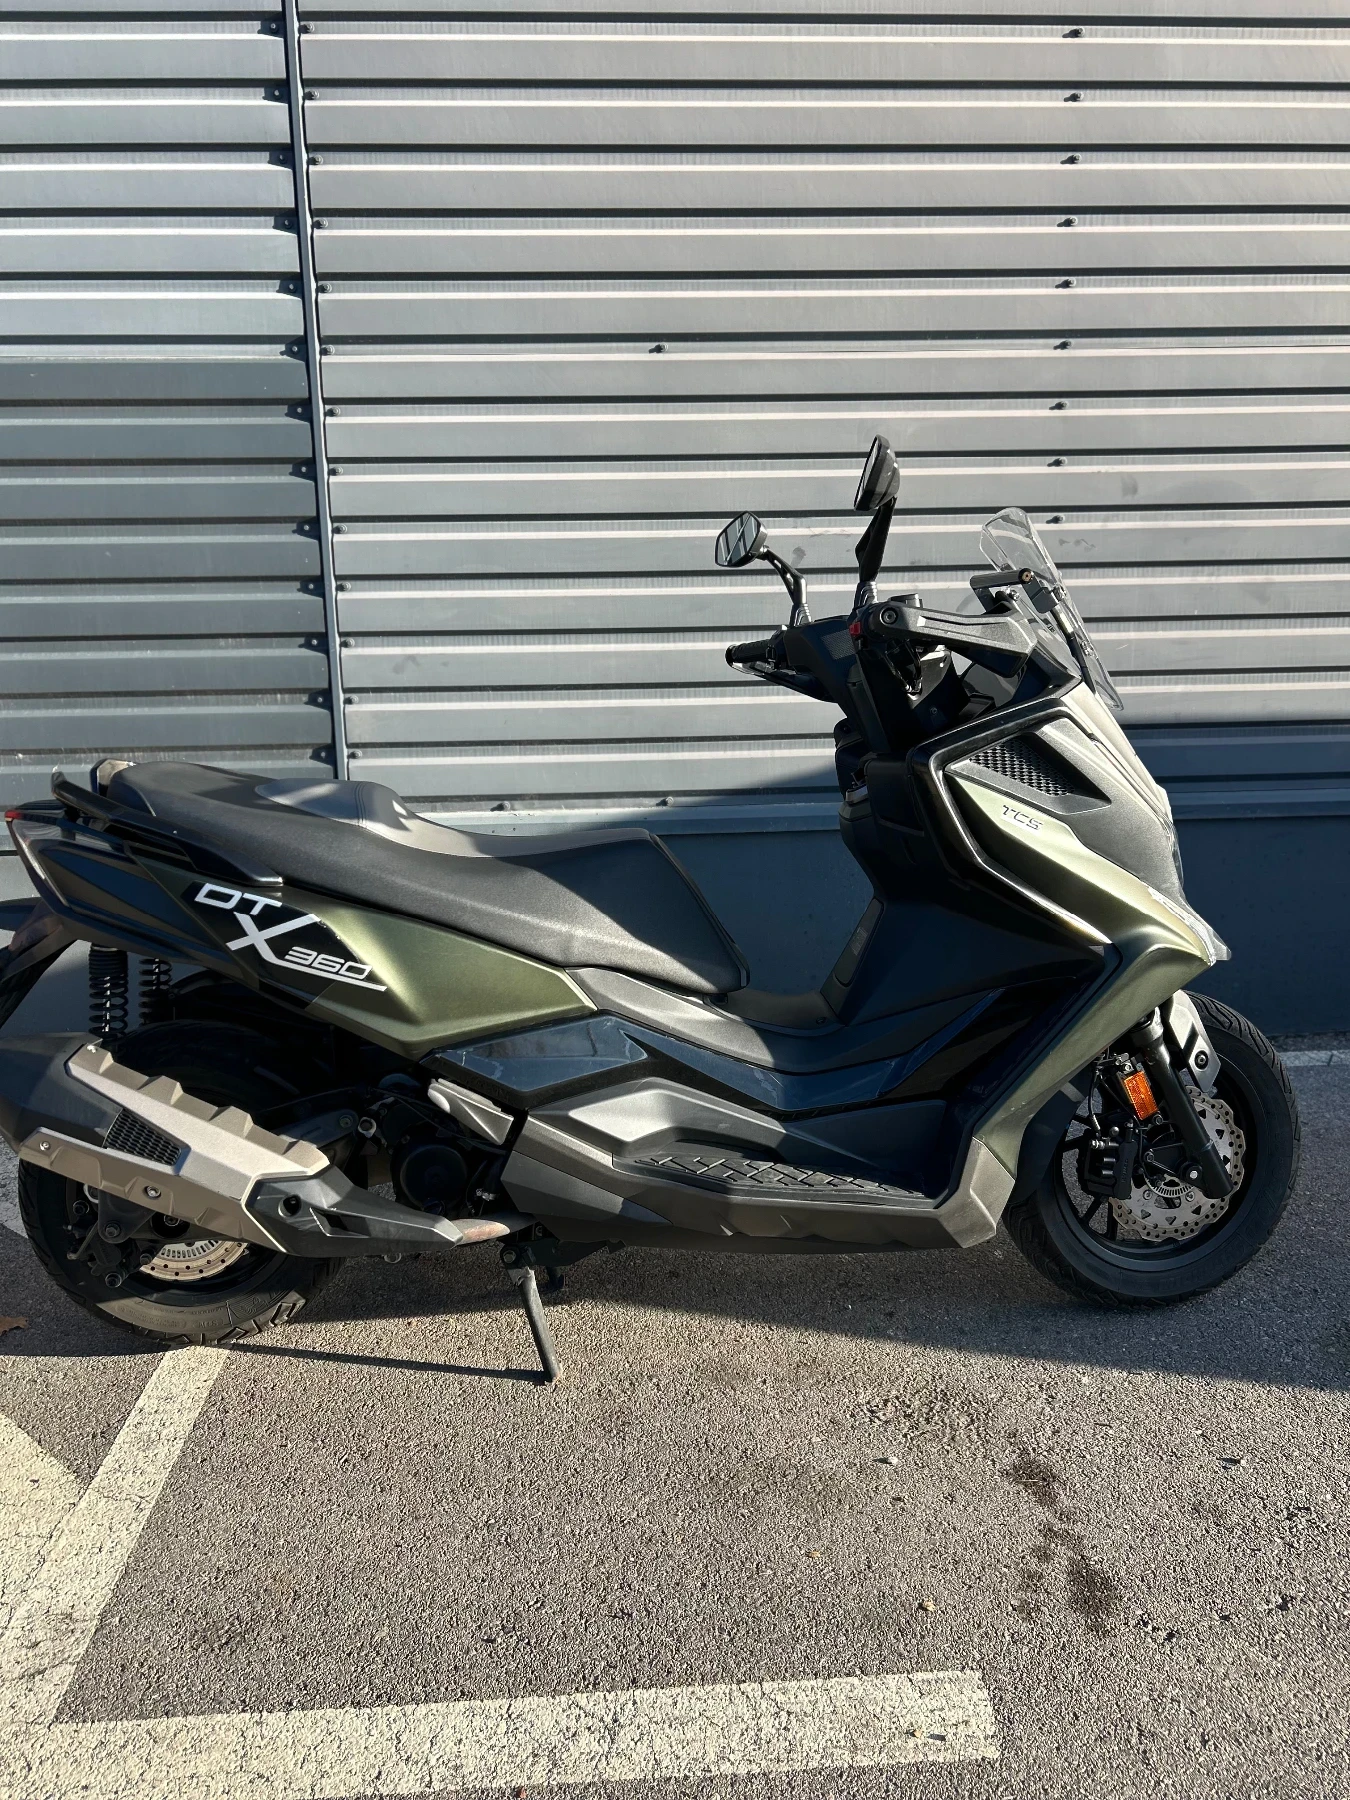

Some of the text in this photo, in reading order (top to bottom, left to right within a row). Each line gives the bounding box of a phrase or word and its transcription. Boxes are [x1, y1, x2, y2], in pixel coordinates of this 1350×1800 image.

[1003, 804, 1043, 830] TCS
[194, 882, 283, 916] DT
[284, 946, 373, 980] 360
